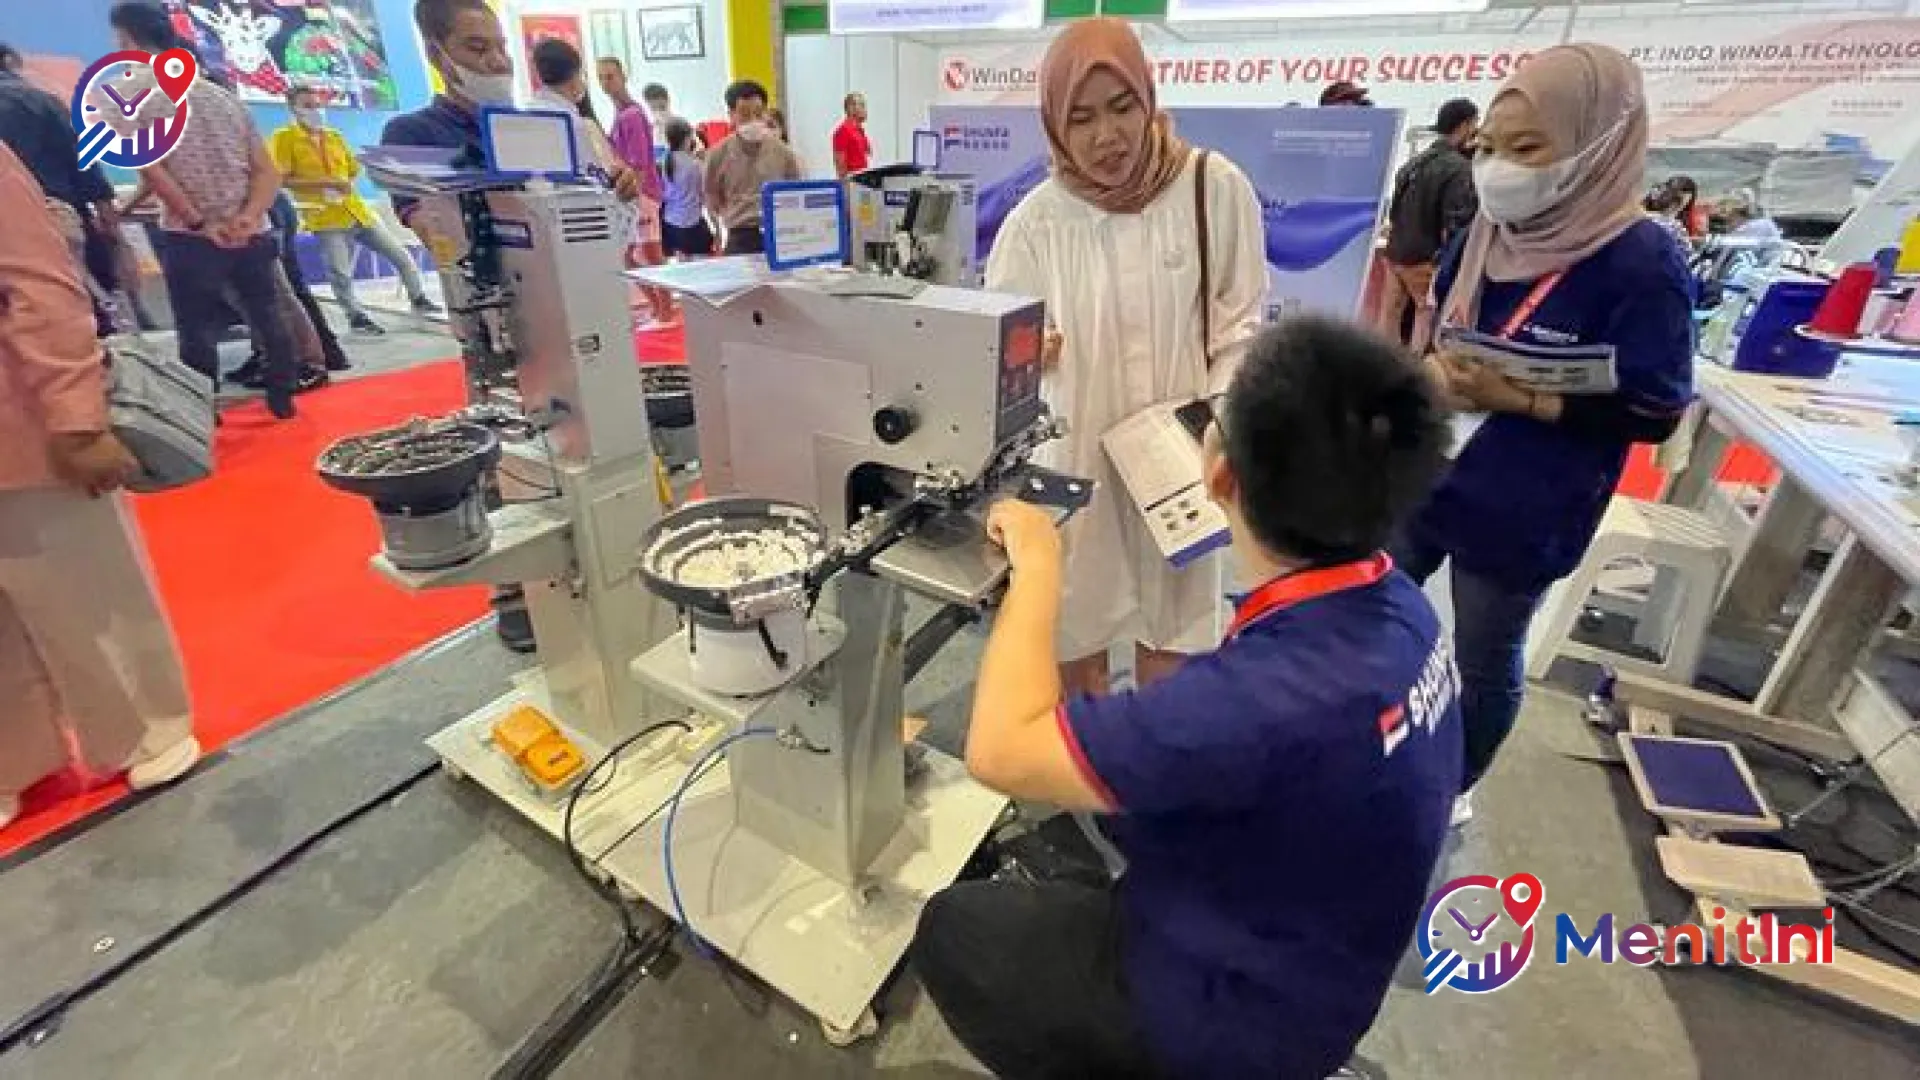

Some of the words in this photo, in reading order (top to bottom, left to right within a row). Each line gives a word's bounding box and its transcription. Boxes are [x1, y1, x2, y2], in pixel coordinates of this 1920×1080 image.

[1660, 45, 1714, 61] INDO
[1719, 44, 1793, 61] WINDA
[1237, 59, 1275, 84] OF
[1280, 57, 1370, 84] YOUR
